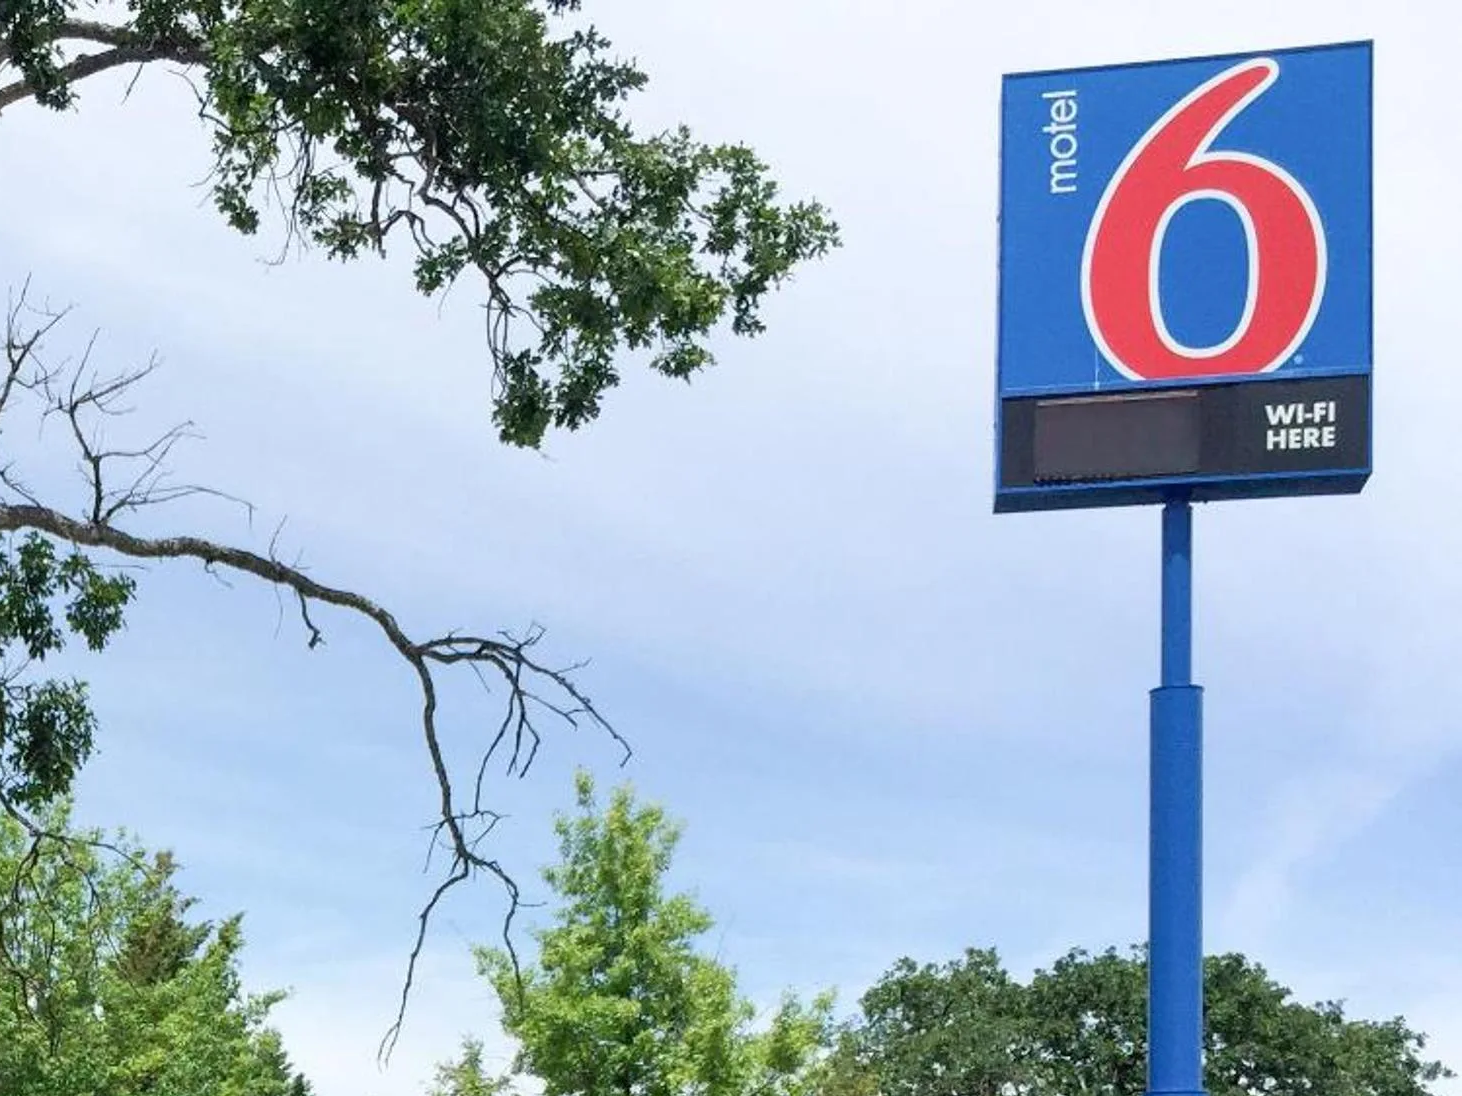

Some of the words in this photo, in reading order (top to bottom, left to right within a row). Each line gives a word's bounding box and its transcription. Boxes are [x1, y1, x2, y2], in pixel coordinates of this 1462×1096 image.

[1041, 90, 1078, 194] motel
[1081, 57, 1328, 381] 6
[1264, 401, 1336, 426] WI-FI
[1266, 426, 1336, 450] HERE
